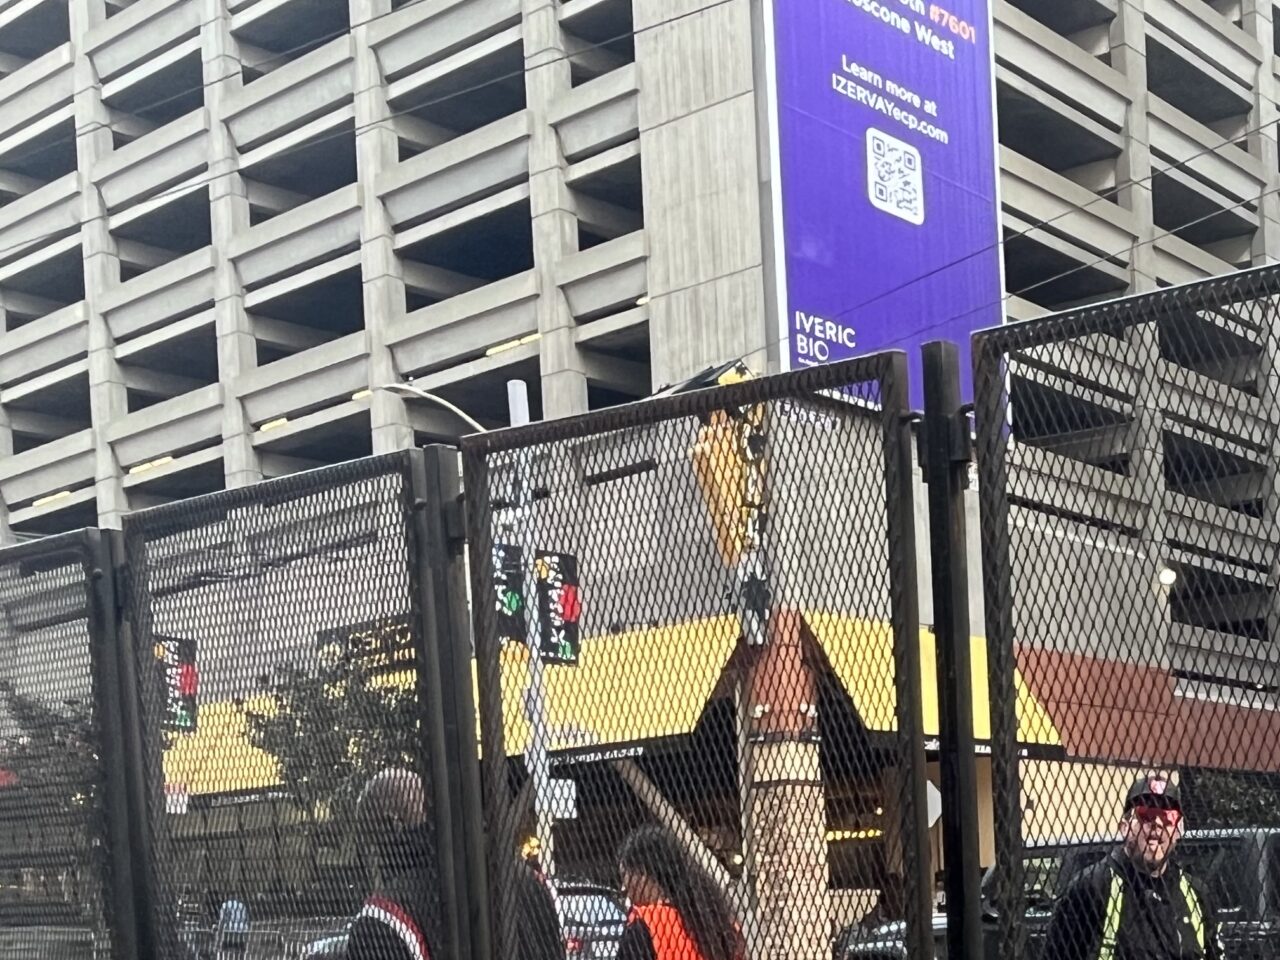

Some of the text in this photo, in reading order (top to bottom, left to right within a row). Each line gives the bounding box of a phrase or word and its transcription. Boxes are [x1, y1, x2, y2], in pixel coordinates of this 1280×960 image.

[847, 0, 955, 60] oscone West
[929, 4, 976, 44] #7601
[832, 73, 949, 145] IZERVAYecp.com
[842, 54, 938, 117] Learn more at
[795, 310, 856, 348] IVERIC
[796, 333, 829, 361] BIO
